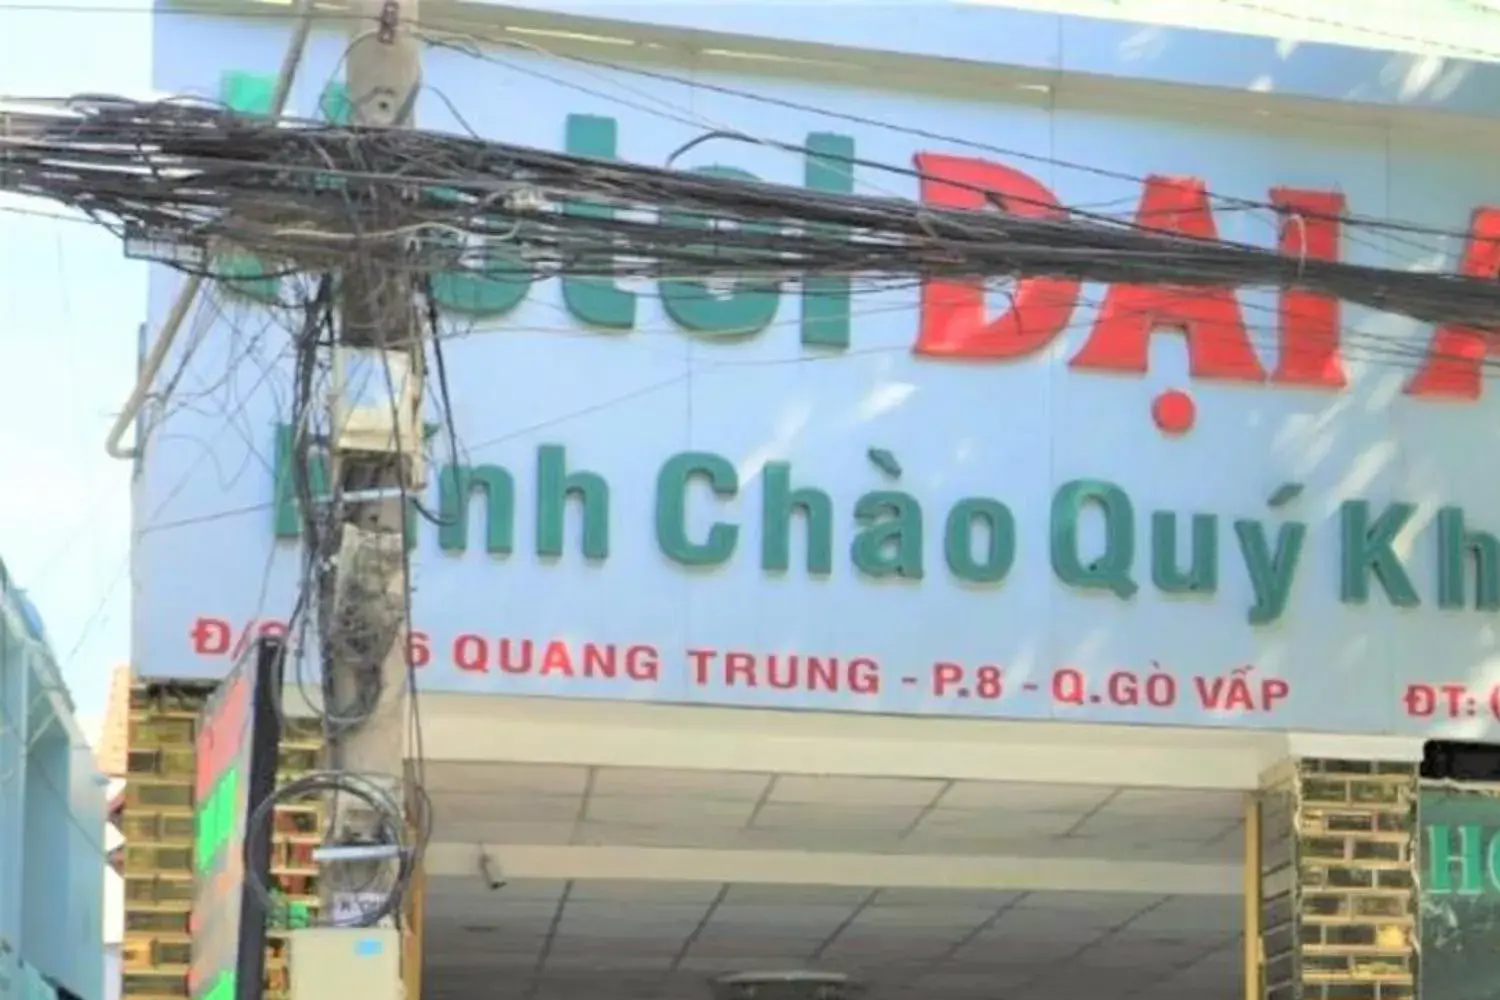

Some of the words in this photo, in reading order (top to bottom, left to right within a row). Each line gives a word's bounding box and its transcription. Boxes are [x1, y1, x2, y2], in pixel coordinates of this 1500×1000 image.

[655, 447, 1017, 592] Chào
[1048, 478, 1308, 626] Quý
[453, 633, 658, 683] QUANG
[686, 649, 880, 695] TRUNG
[932, 662, 1001, 699] P.8
[1052, 659, 1176, 707] Q.GÒ
[1194, 664, 1289, 712] VẤP
[1404, 684, 1476, 719] ĐT:
